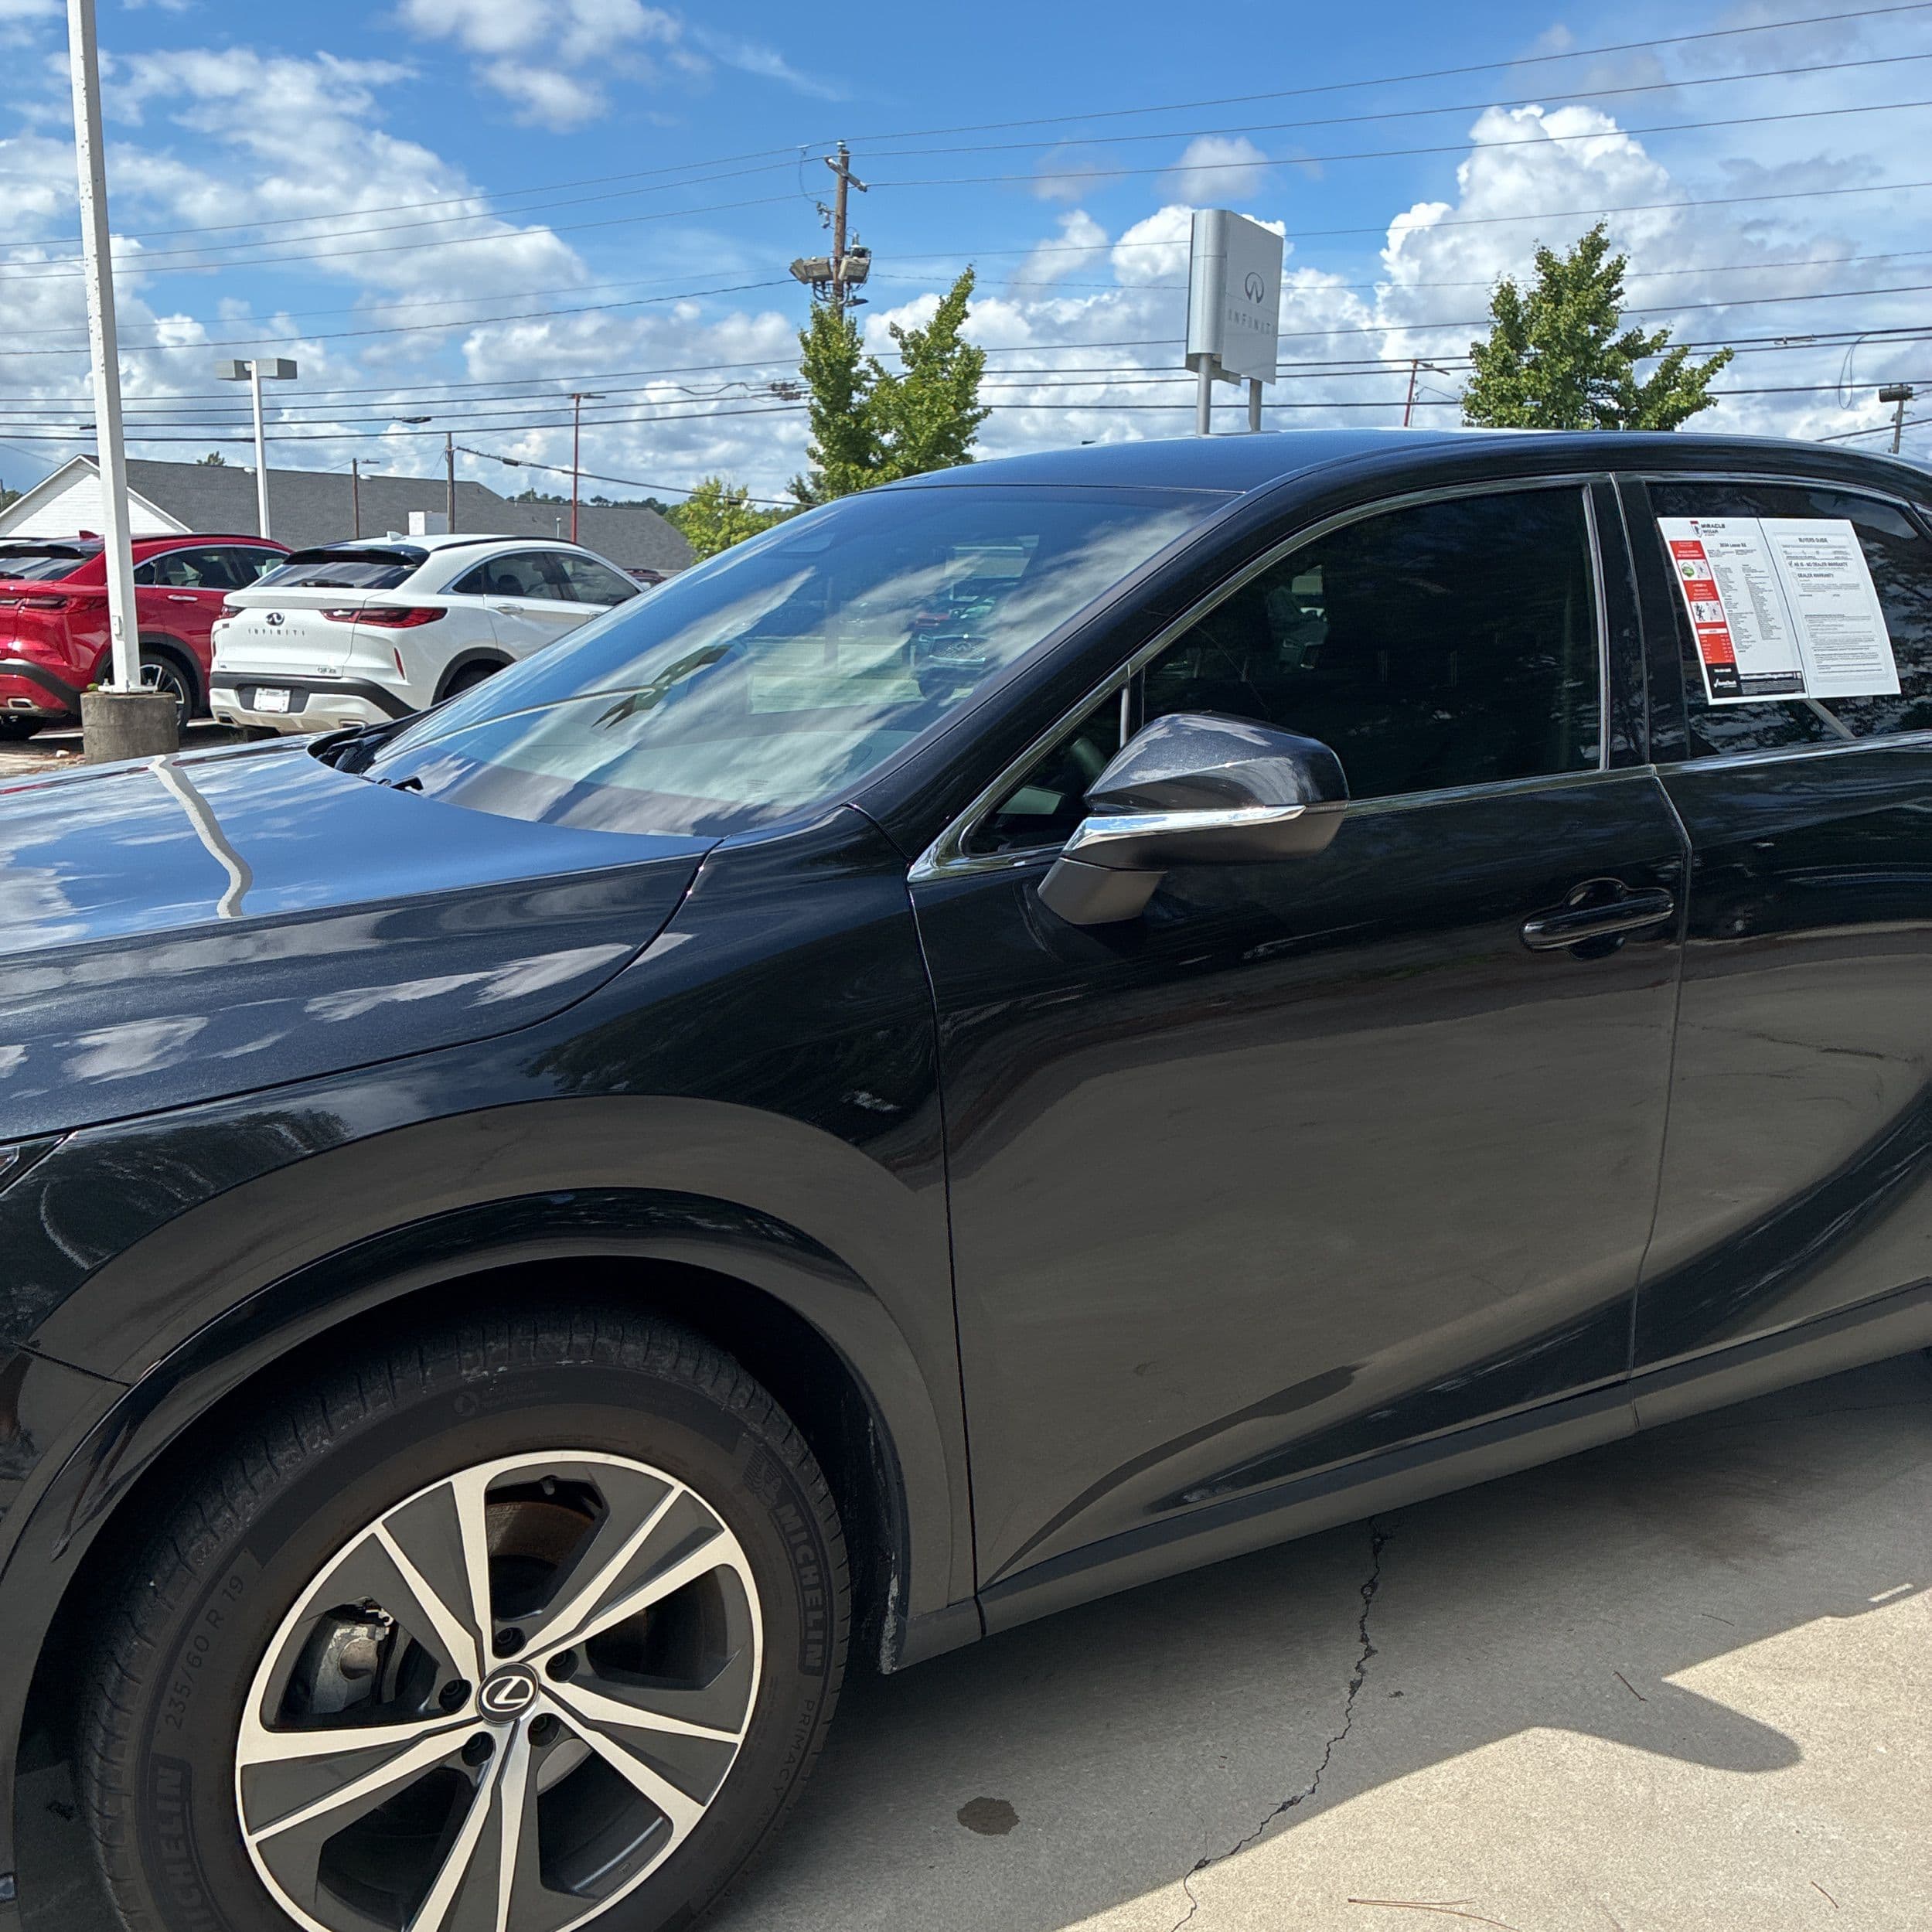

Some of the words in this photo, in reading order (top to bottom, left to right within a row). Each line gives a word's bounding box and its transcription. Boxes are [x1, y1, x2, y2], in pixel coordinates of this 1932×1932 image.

[1228, 308, 1276, 338] INFINITI
[248, 628, 305, 637] INFINITI
[775, 1501, 826, 1668] MICHELIN
[165, 1634, 210, 1731] 235/60
[205, 1608, 225, 1630] R
[221, 1574, 244, 1603] 19
[772, 1698, 816, 1804] PRIMACY
[155, 1767, 220, 1932] ICHELIN
